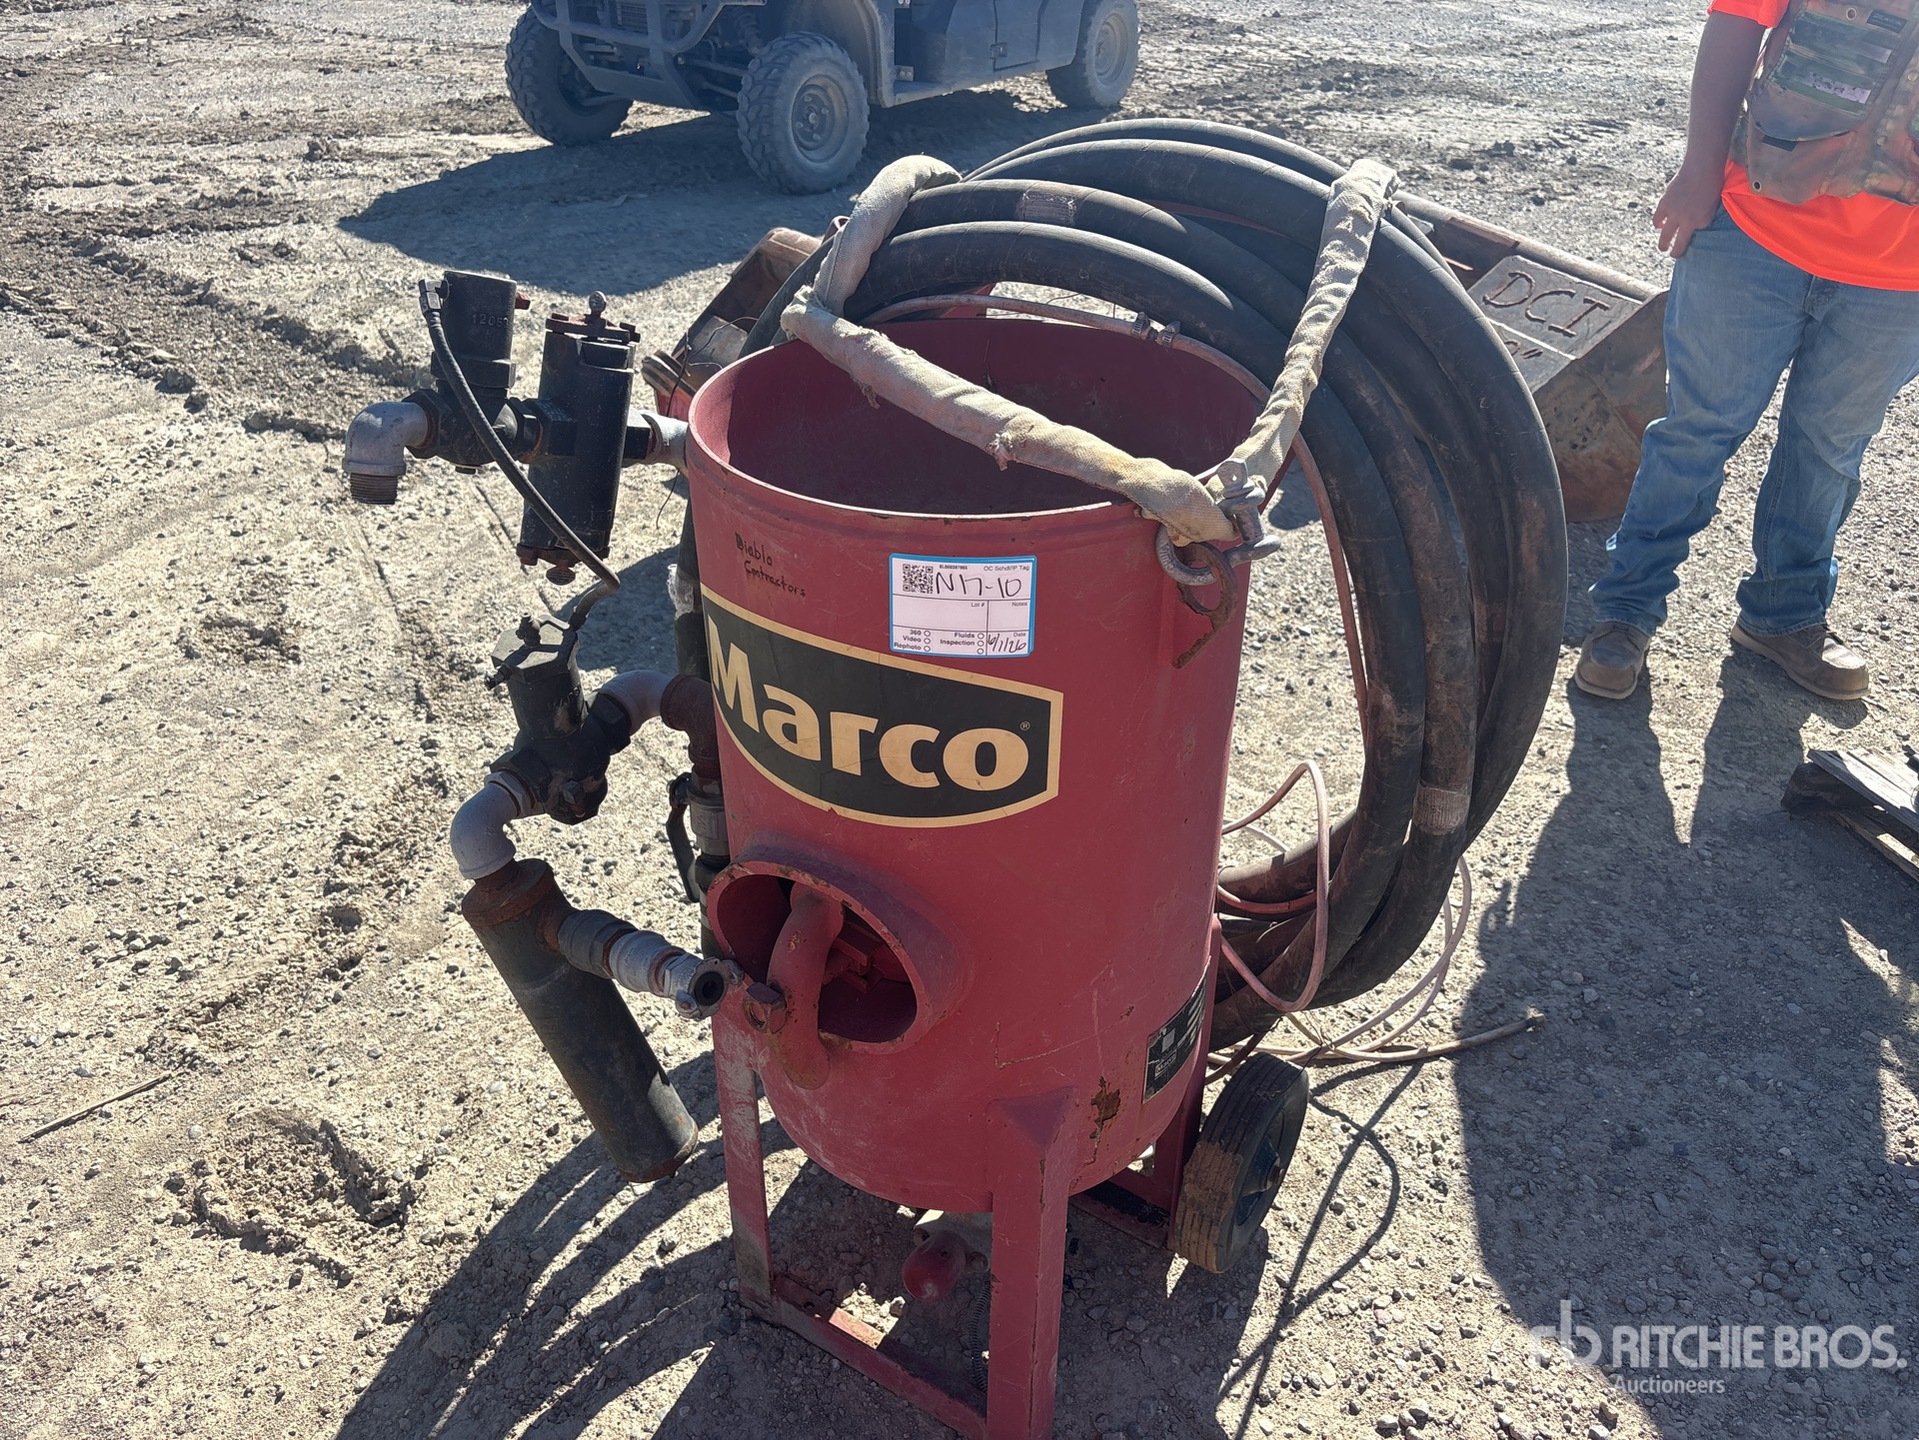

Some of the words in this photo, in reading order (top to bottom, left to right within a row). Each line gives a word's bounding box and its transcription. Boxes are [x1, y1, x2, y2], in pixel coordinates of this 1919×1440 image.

[1482, 270, 1611, 338] DCI
[744, 560, 806, 597] Contractors
[894, 642, 922, 651] Rephoto
[940, 639, 975, 647] Inspection
[707, 614, 1029, 792] Marco
